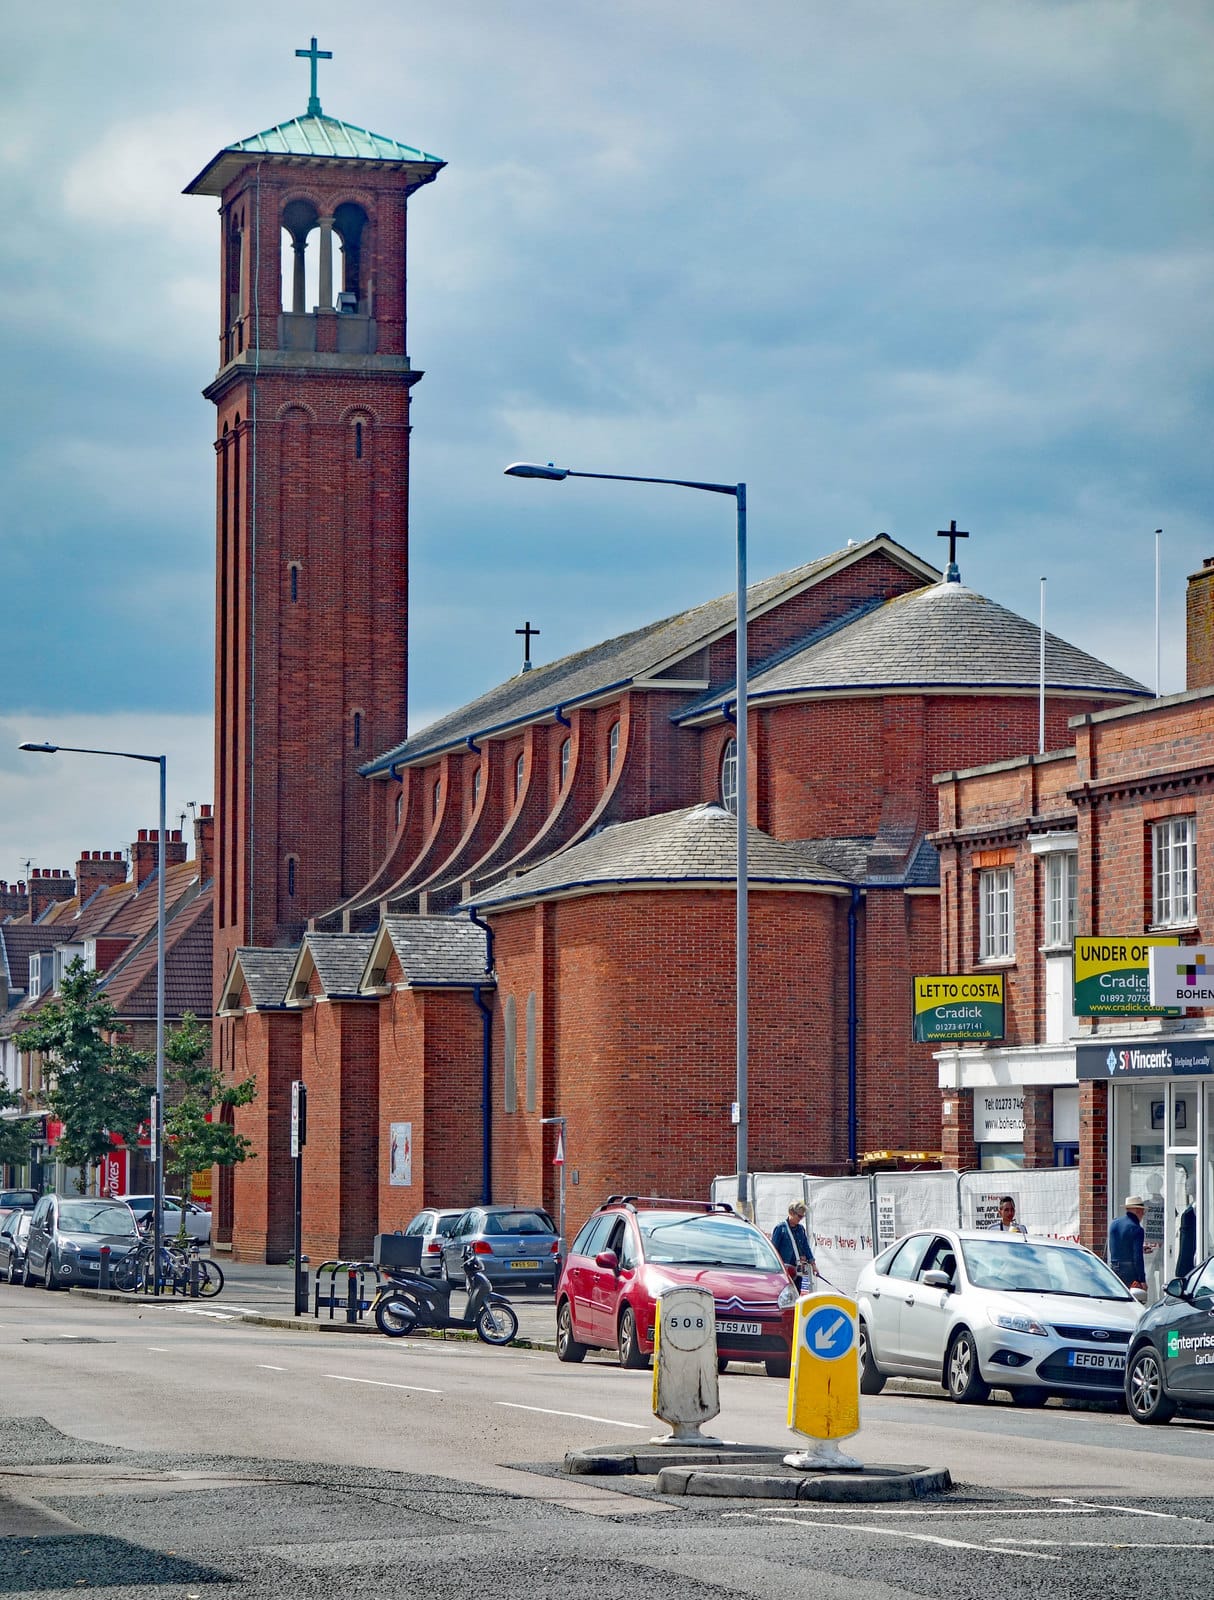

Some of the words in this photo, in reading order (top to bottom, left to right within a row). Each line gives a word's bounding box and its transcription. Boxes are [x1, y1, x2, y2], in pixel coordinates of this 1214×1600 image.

[1081, 946, 1127, 961] UNDER
[920, 984, 941, 998] LET
[942, 984, 958, 997] TO
[961, 984, 1000, 997] COSTA
[1100, 994, 1125, 1003] 01892
[935, 1006, 982, 1019] Cradick
[935, 1023, 956, 1031] 01273
[927, 1030, 991, 1038] www.cradick.co.uk
[1130, 1048, 1173, 1070] Vincent's
[1174, 1057, 1193, 1067] Helping
[1193, 1055, 1211, 1066] Locally
[995, 1098, 1012, 1111] 01273
[740, 1324, 758, 1334] AVD
[1171, 1332, 1214, 1352] enterprise
[1076, 1354, 1106, 1366] EF08
